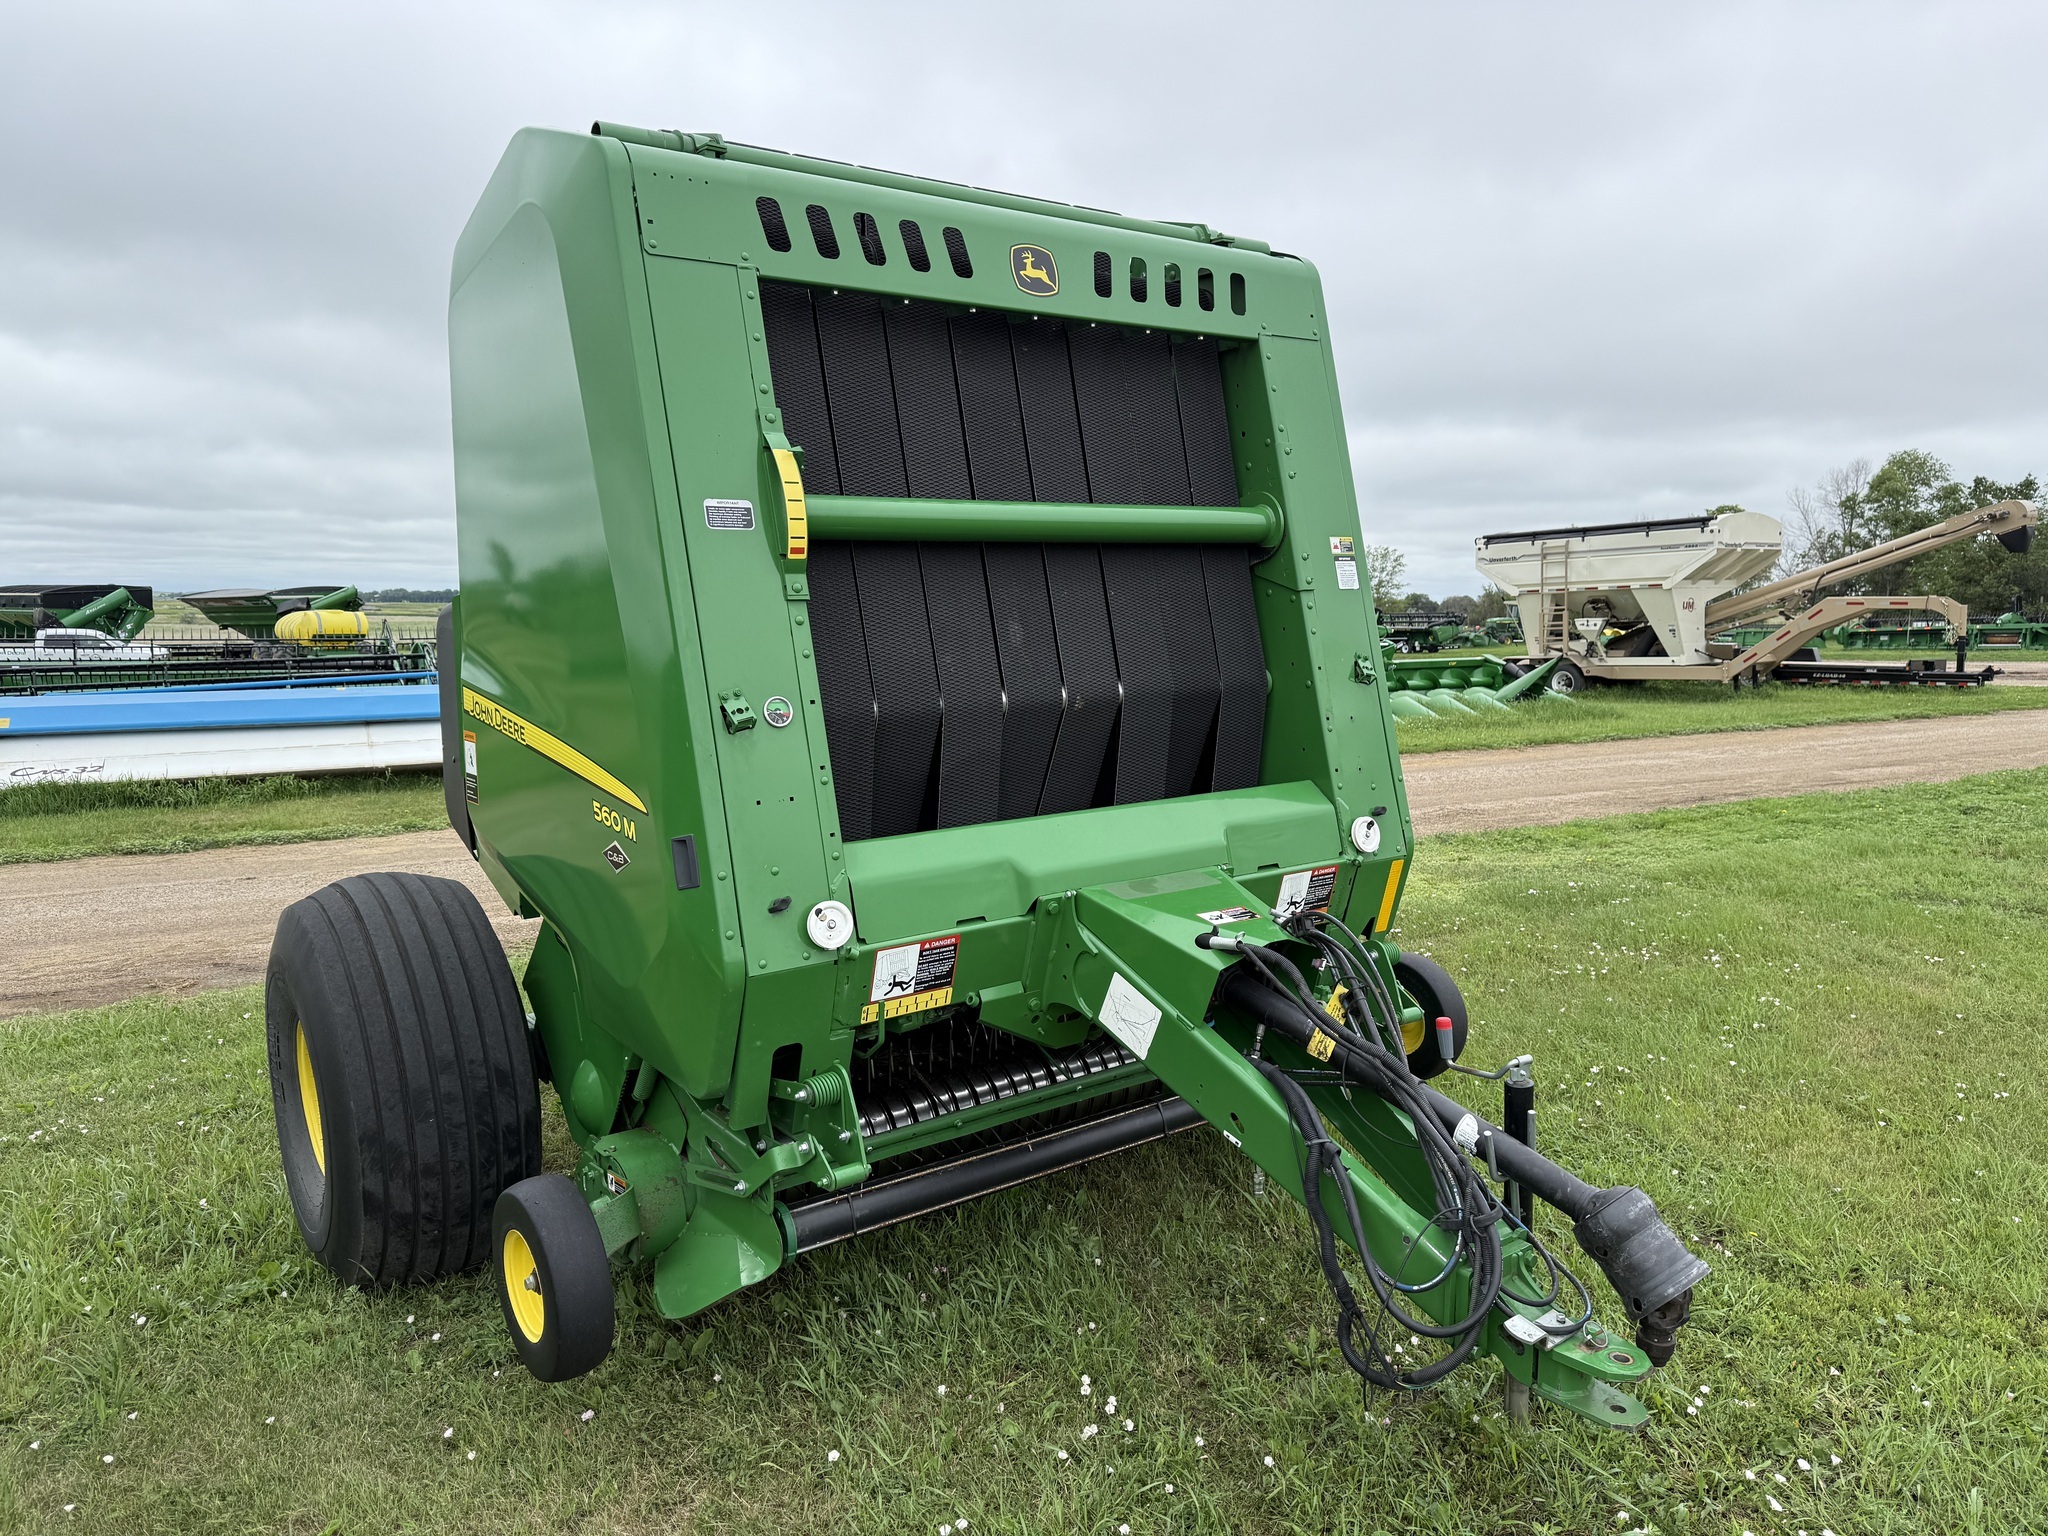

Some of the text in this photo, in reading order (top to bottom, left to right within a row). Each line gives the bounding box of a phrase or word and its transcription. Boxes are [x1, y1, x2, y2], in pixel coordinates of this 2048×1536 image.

[470, 695, 526, 743] JOHN DEERE
[592, 799, 637, 843] 560 M
[607, 851, 624, 864] C&B
[931, 937, 956, 948] DANGER
